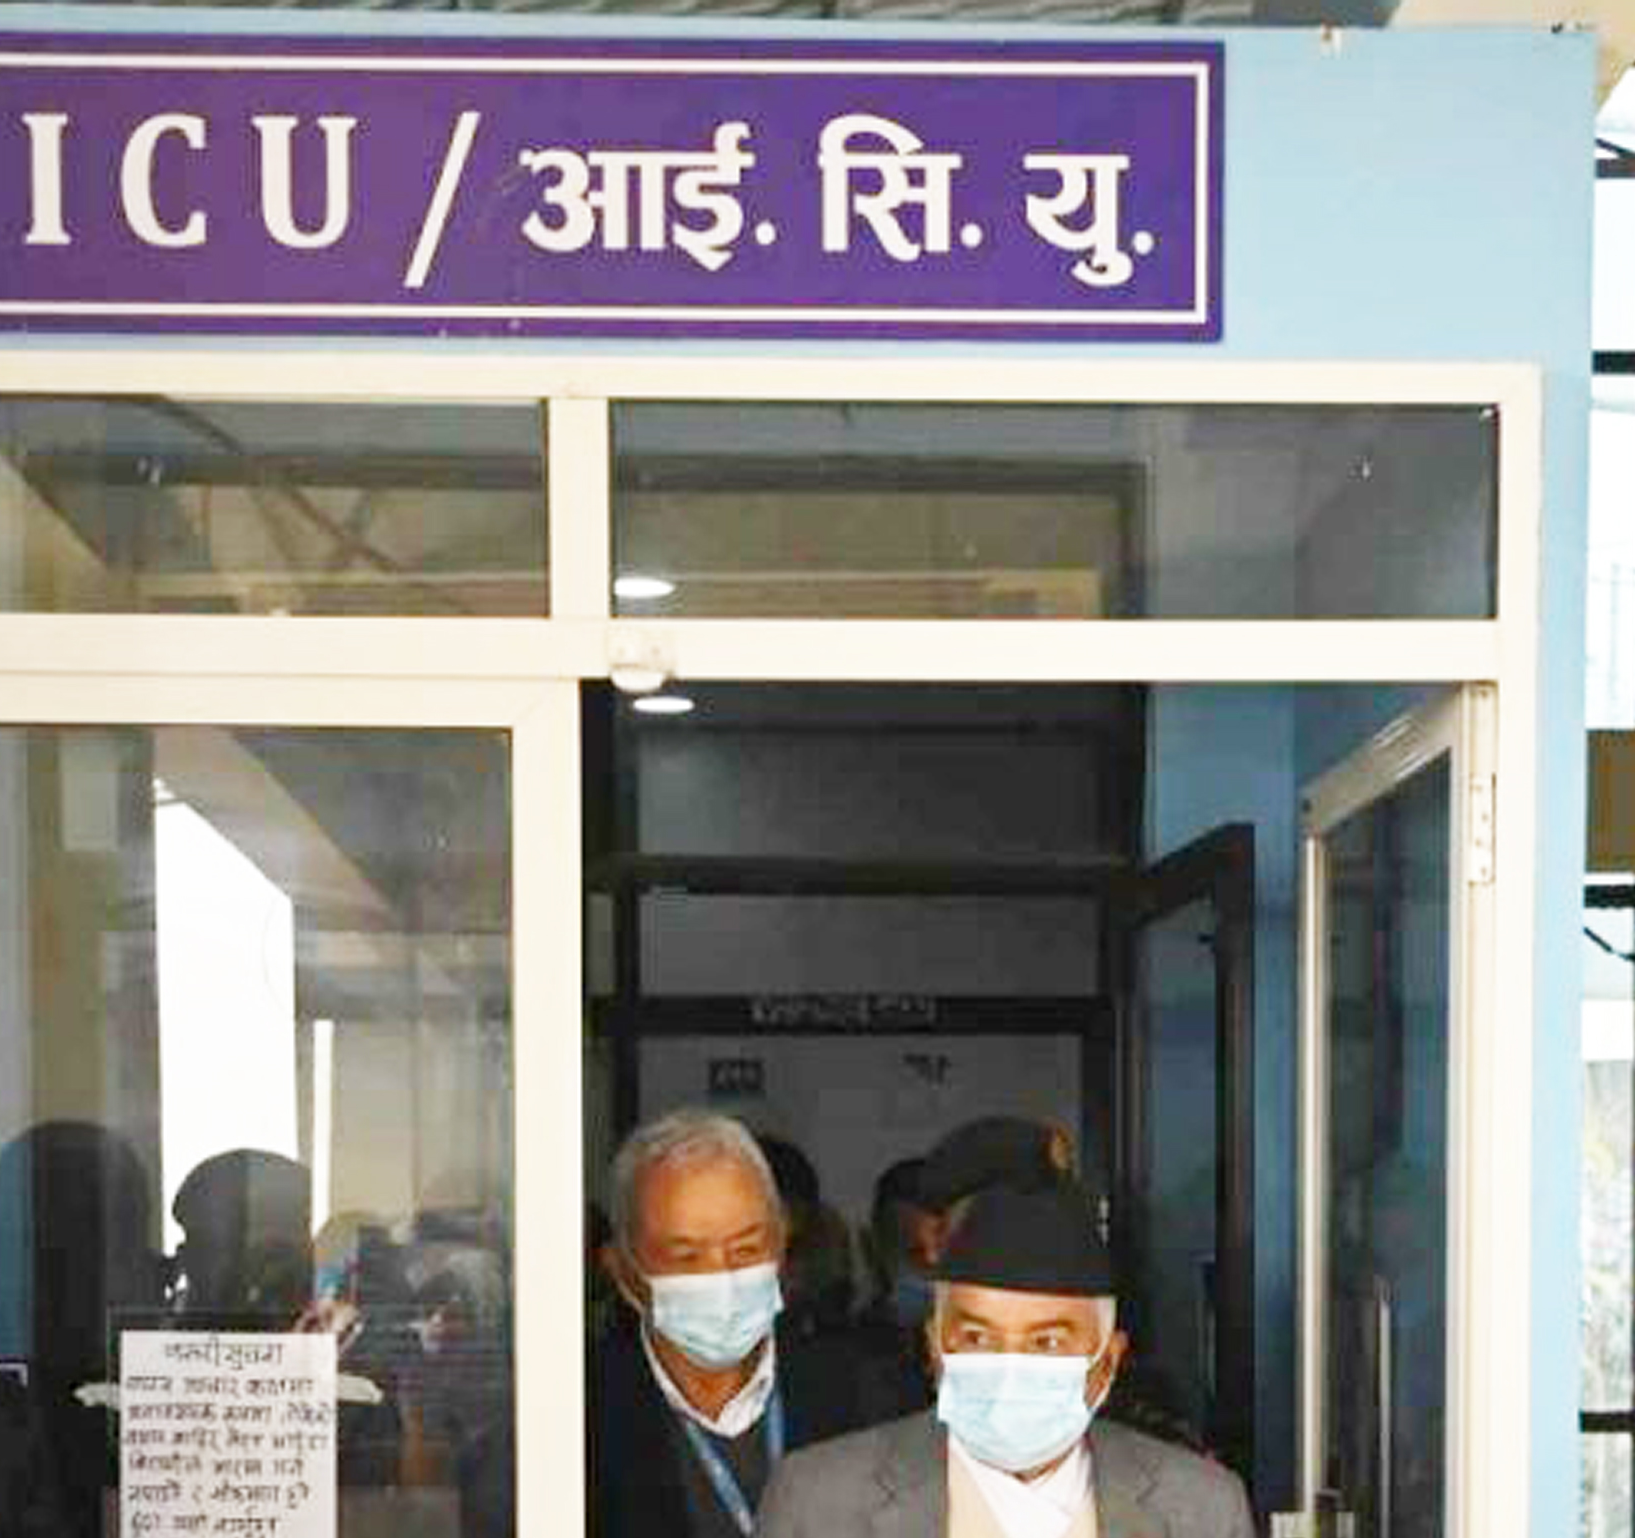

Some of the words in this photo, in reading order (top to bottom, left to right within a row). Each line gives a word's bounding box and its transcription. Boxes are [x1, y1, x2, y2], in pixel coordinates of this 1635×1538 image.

[19, 111, 359, 249] ICU
[521, 119, 777, 272] आई.
[819, 117, 983, 263] सि.
[1025, 151, 1156, 284] यु.
